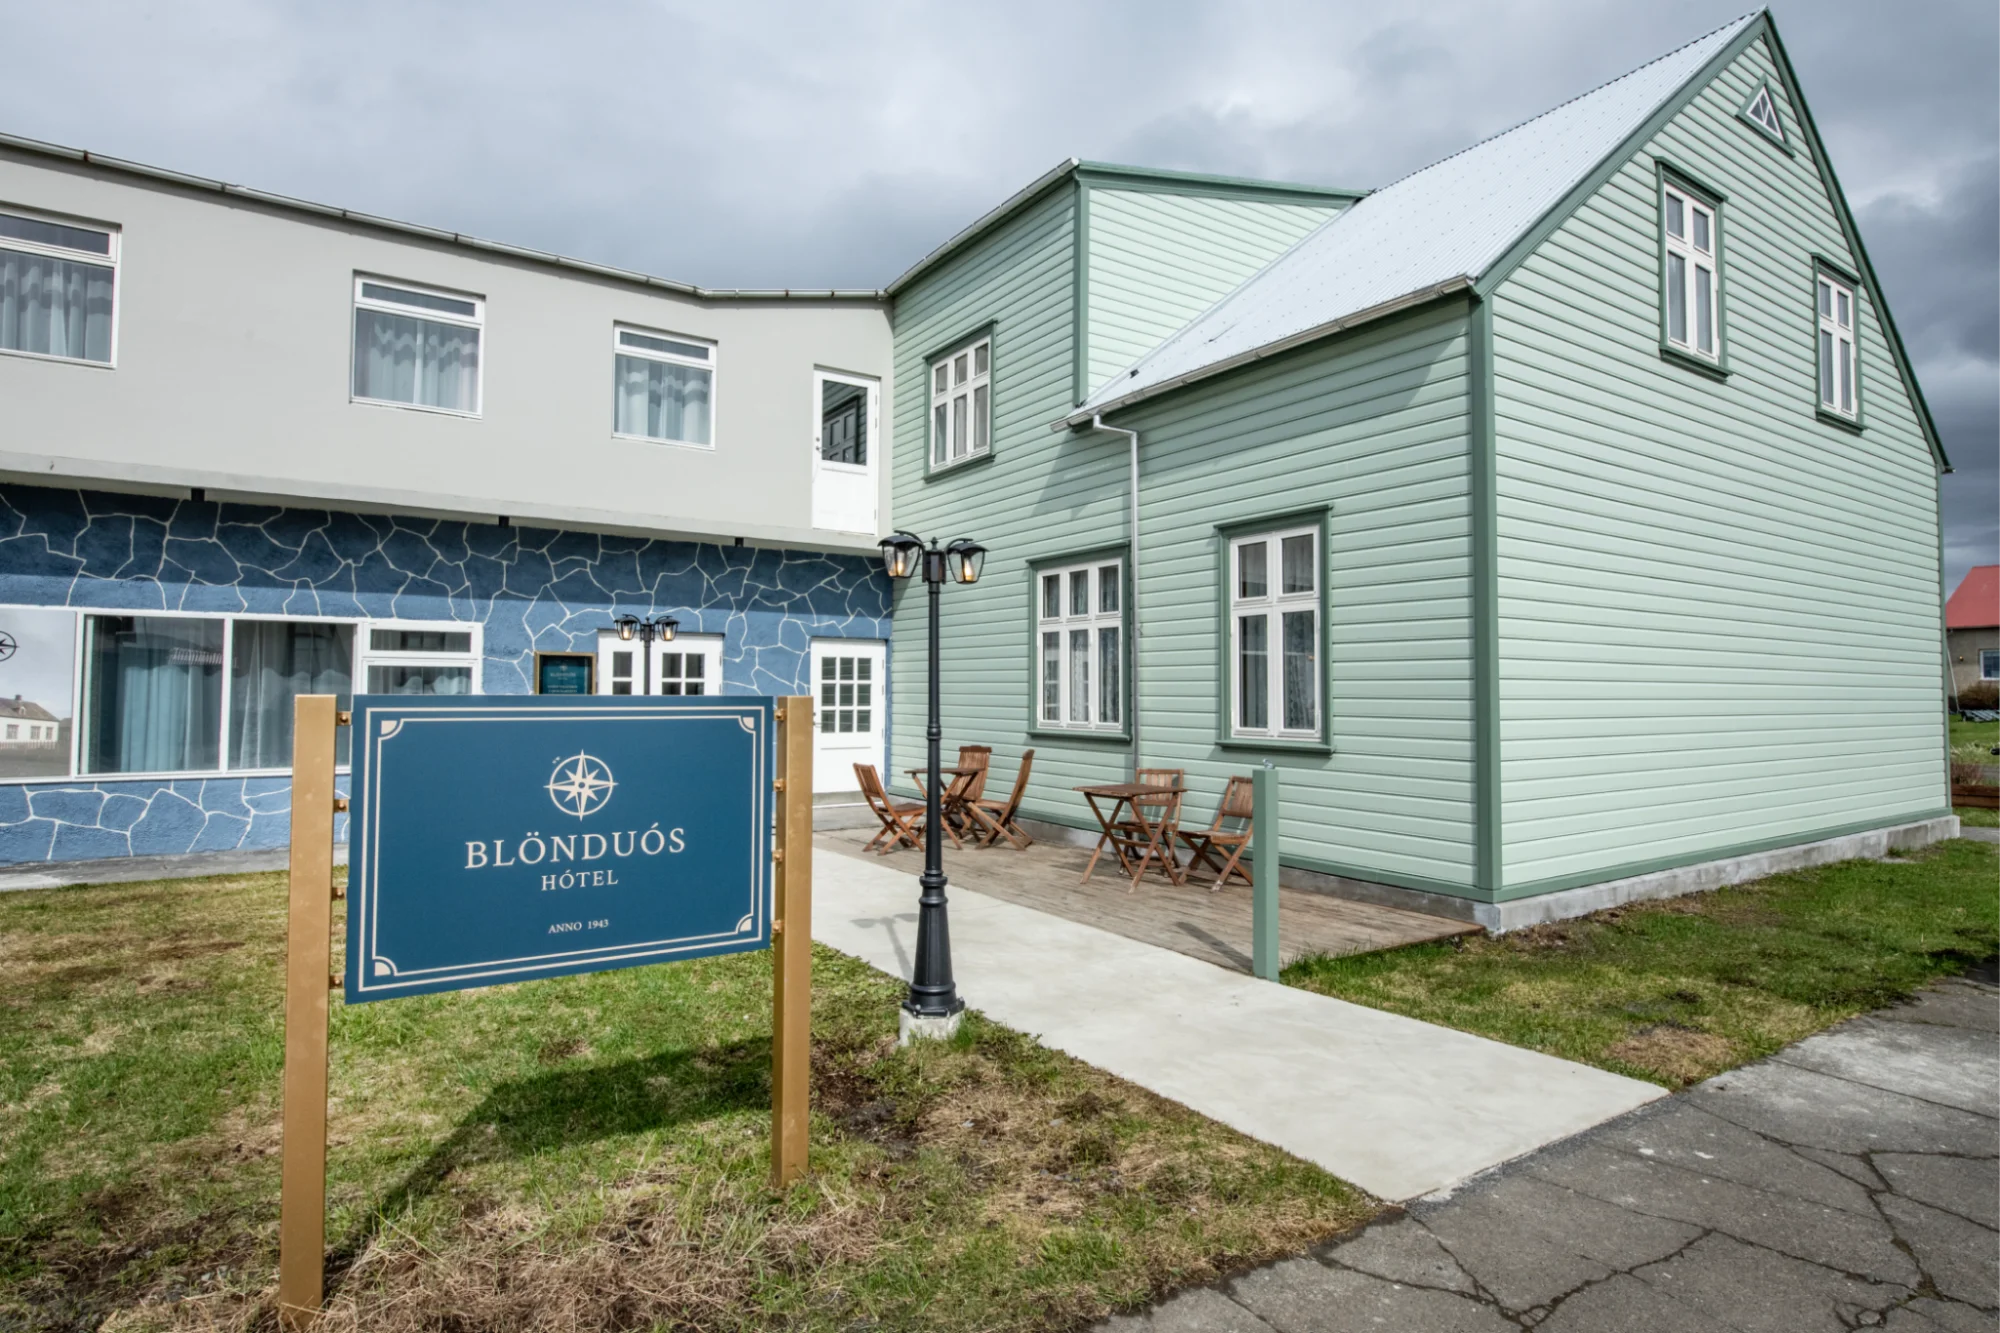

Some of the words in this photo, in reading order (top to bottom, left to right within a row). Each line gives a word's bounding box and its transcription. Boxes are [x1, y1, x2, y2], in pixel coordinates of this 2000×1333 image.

[464, 822, 685, 869] BLÖNDUÓS
[541, 869, 619, 891] HÓTEL
[548, 921, 583, 934] ANNO
[588, 918, 609, 930] 1943
